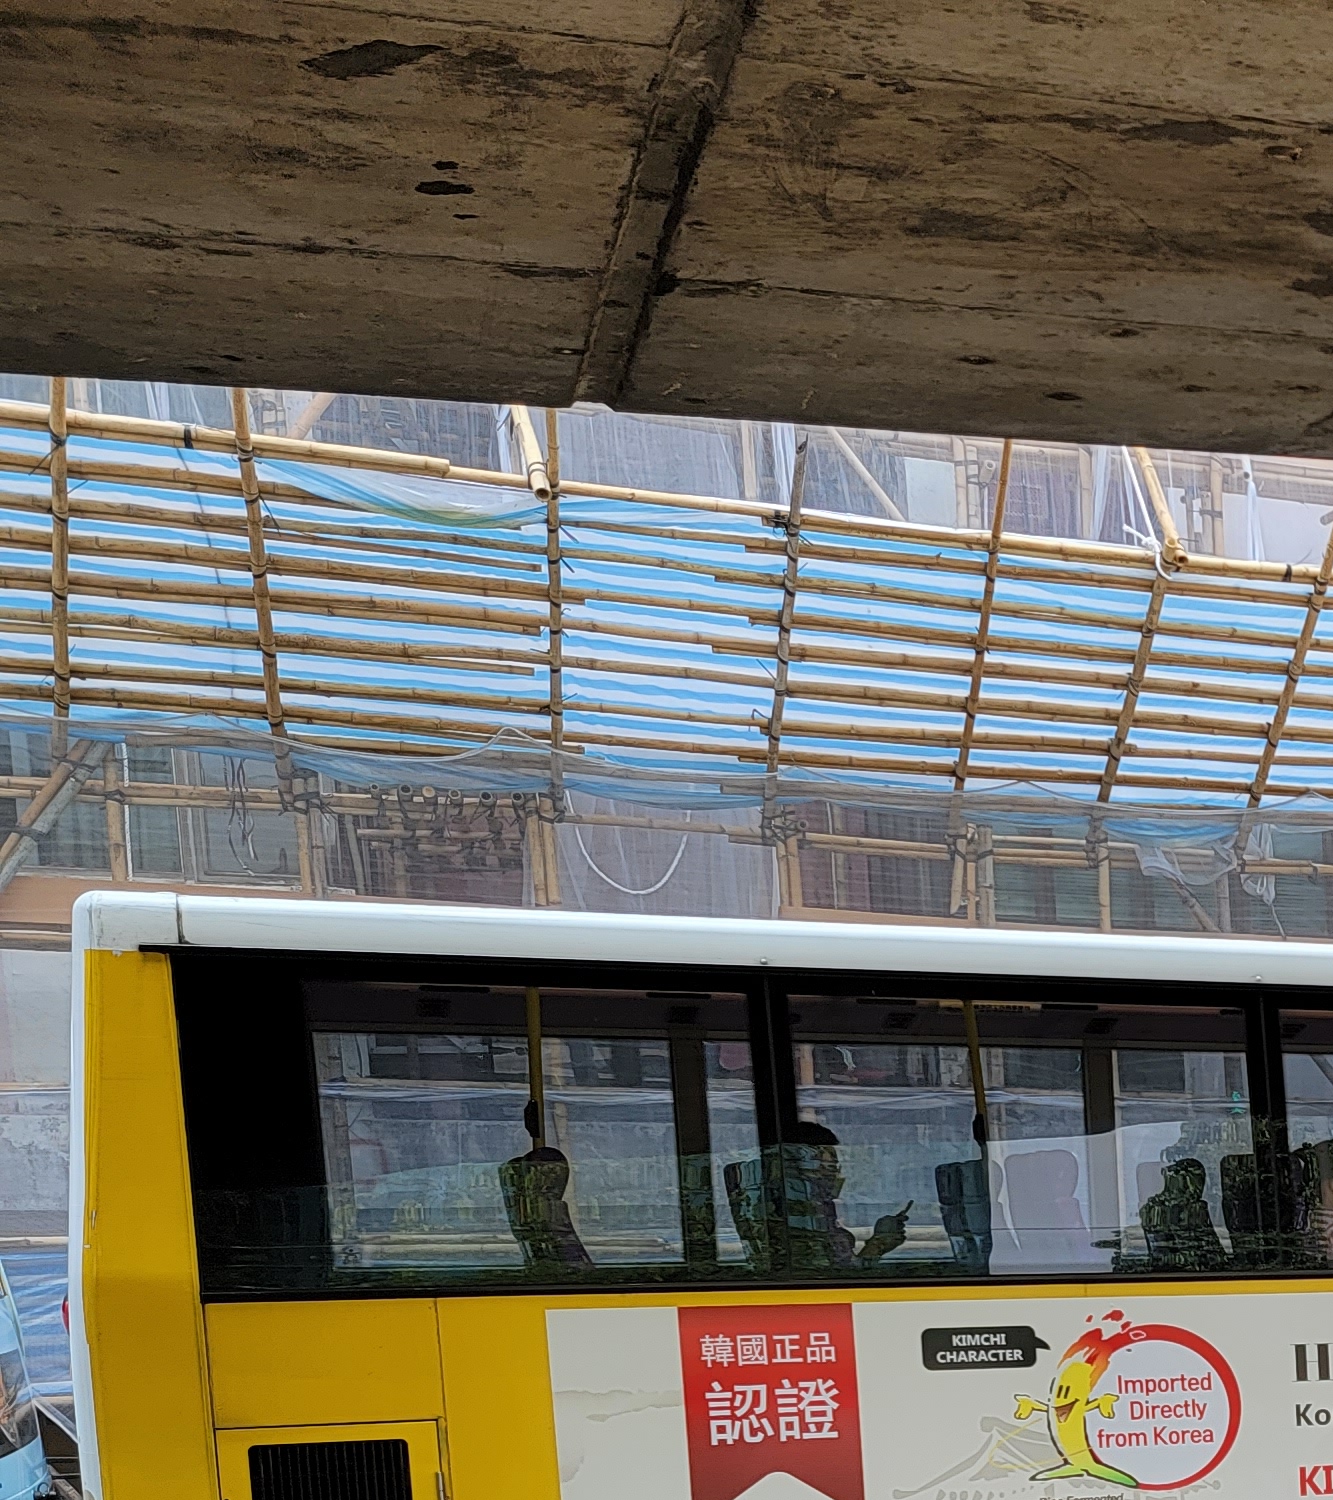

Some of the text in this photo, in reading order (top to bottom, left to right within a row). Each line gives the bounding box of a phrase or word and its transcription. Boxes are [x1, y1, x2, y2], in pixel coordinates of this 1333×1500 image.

[699, 1332, 837, 1368] 韓國正品
[951, 1333, 1007, 1347] KIMCHI
[935, 1349, 1025, 1364] CHARACTER
[1117, 1372, 1212, 1396] Imported
[704, 1378, 840, 1446] 認證
[1130, 1398, 1208, 1421] Directly
[1097, 1427, 1215, 1448] from Korea
